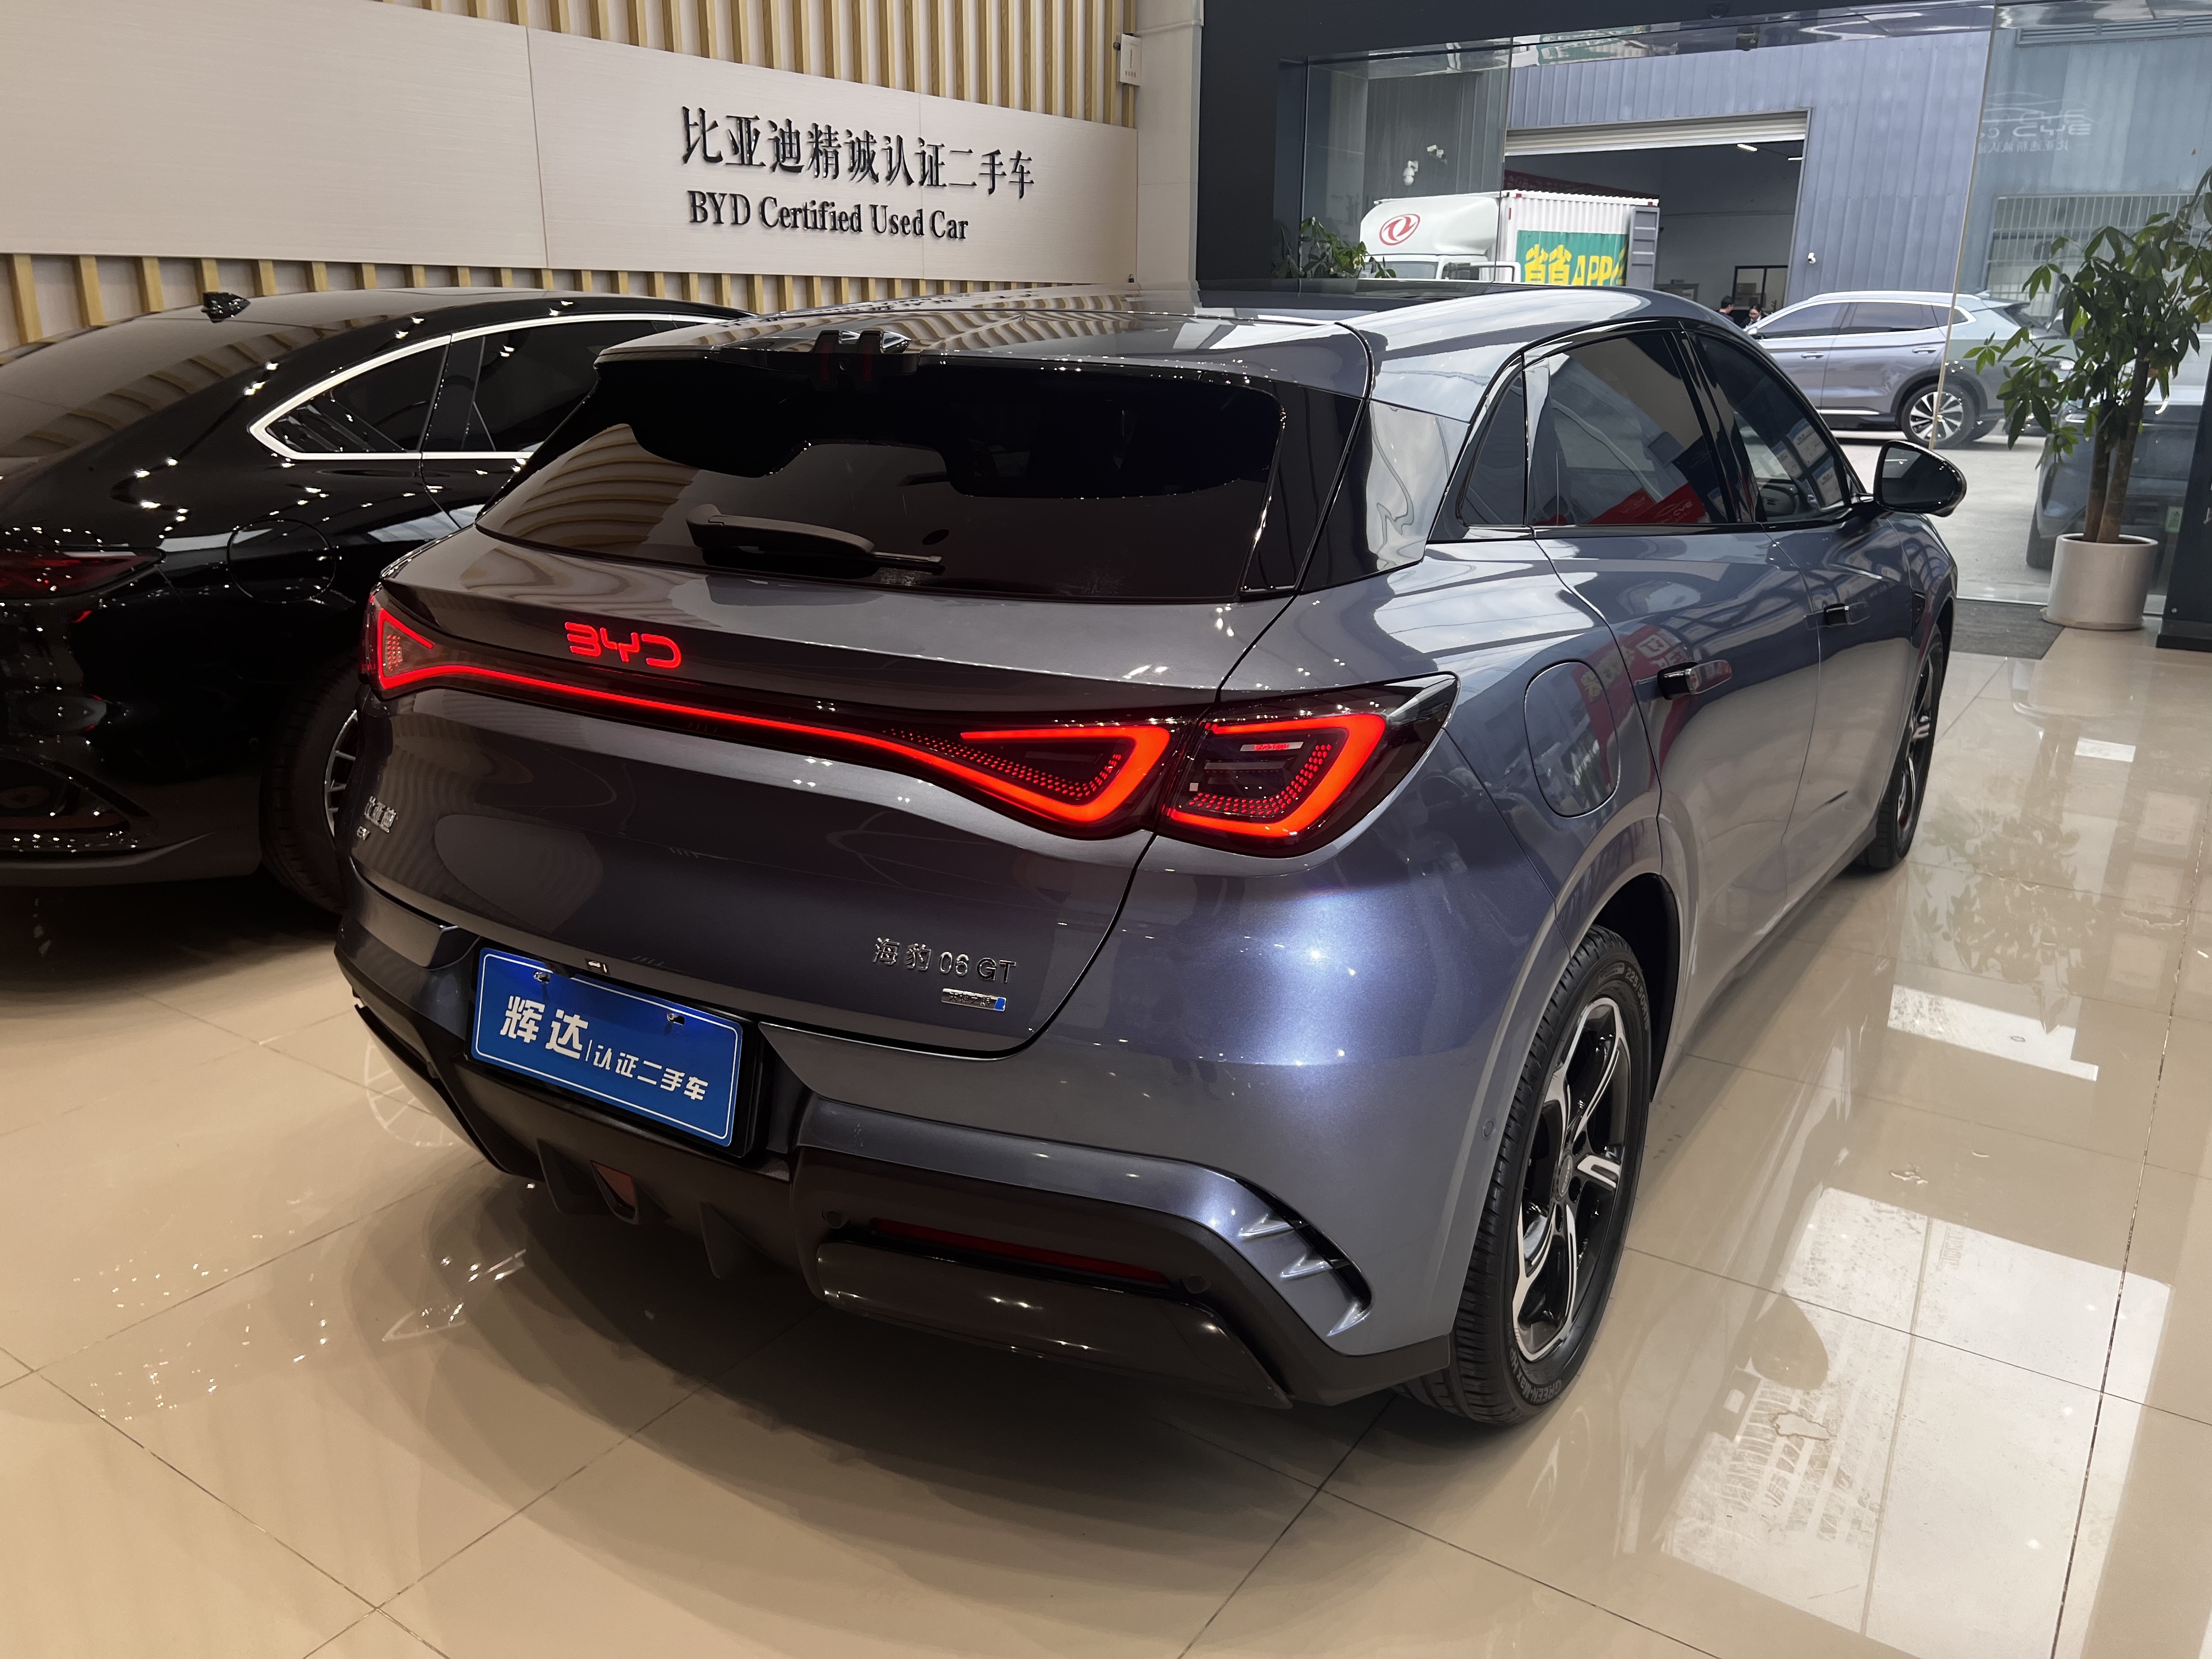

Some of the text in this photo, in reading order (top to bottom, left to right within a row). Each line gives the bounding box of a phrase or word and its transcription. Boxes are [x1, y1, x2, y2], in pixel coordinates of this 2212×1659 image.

[682, 106, 1034, 199] 比亚迪精诚认证二手车
[687, 190, 969, 240] BYD Certified Used Car
[565, 622, 682, 669] BYD
[872, 936, 1017, 983] 海豹 06 GT
[500, 995, 709, 1101] 辉达 认证二手车
